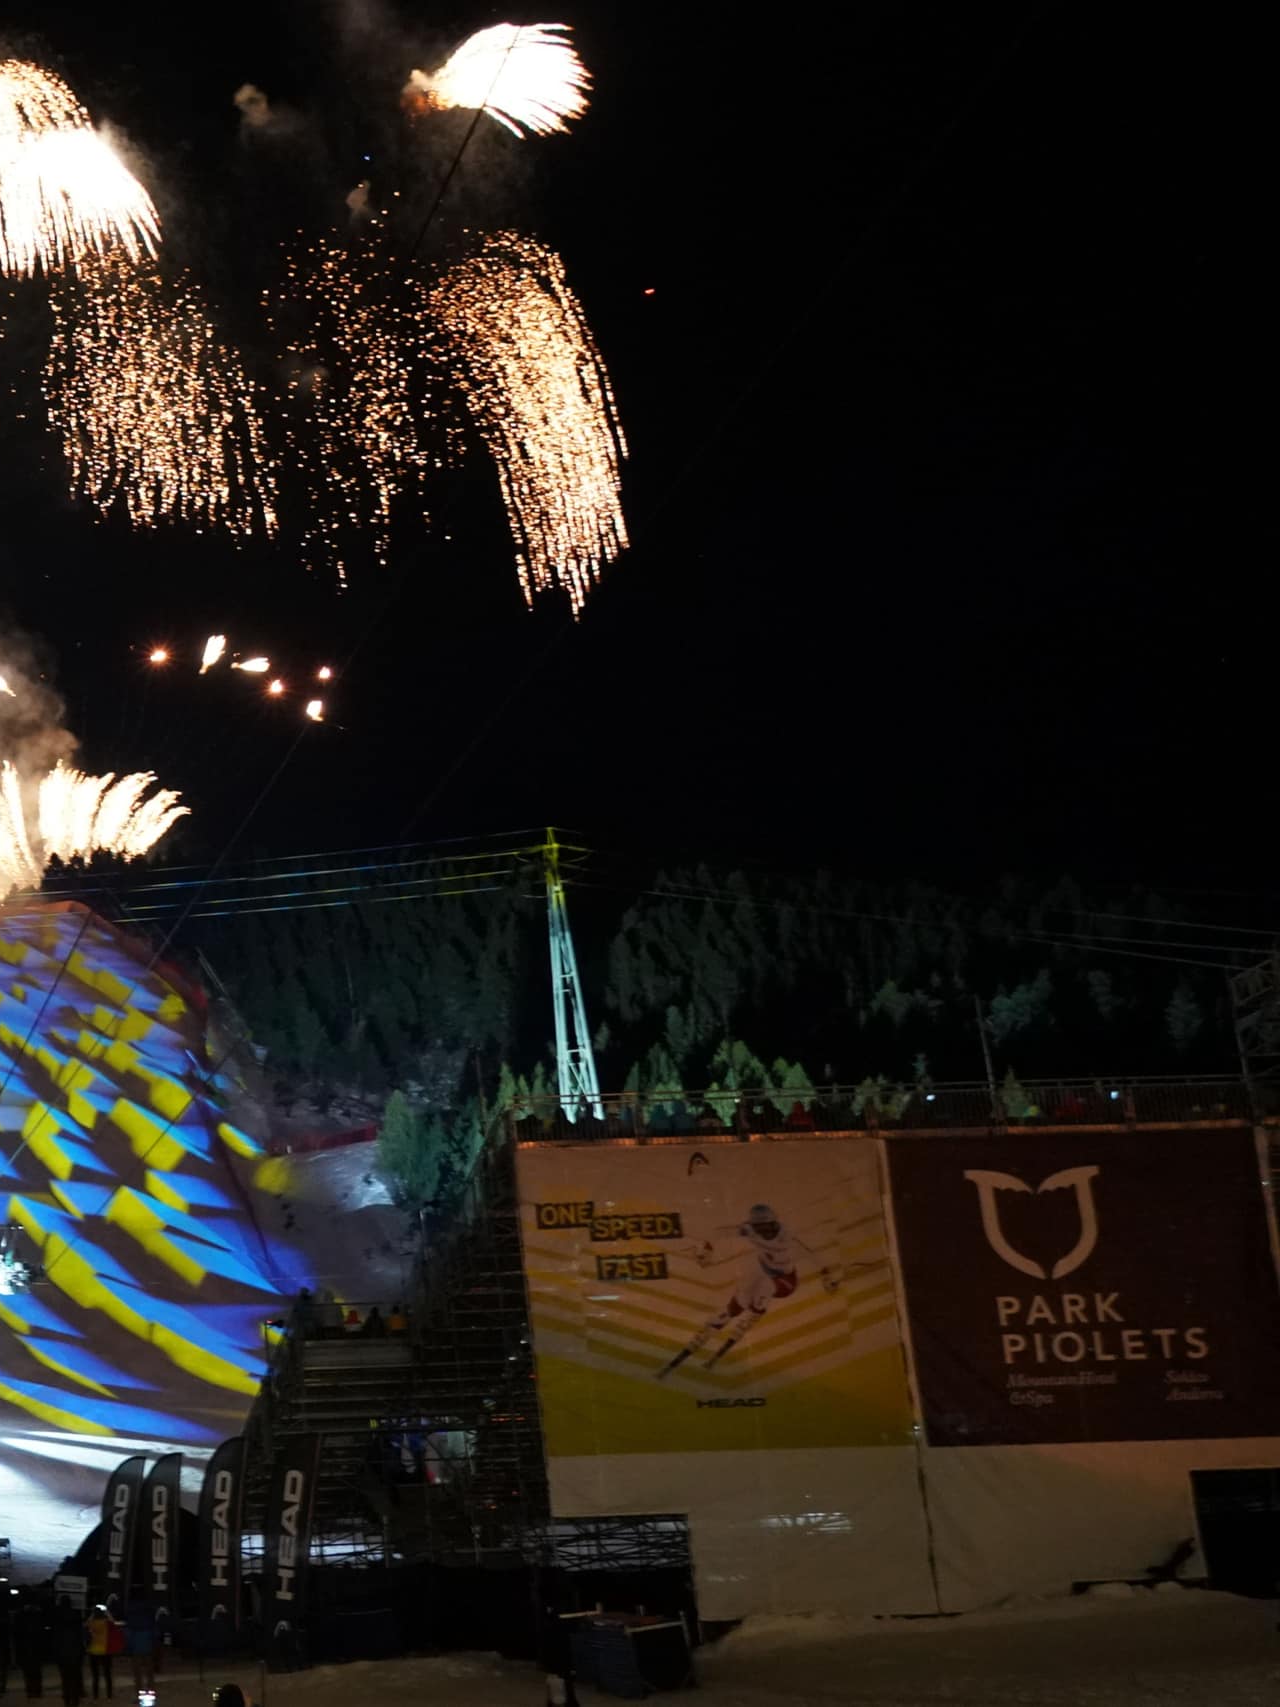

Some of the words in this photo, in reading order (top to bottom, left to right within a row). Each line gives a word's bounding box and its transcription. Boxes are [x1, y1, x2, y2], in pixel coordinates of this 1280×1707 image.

[540, 1204, 593, 1226] ONE
[601, 1255, 663, 1278] FAST
[995, 1292, 1125, 1327] PARK
[1001, 1327, 1209, 1365] PIOLETS
[696, 1398, 767, 1409] HEAD
[107, 1483, 130, 1580] HEAD
[152, 1484, 169, 1592] HEAD
[210, 1469, 233, 1587] HEAD
[274, 1469, 305, 1601] HEAD
